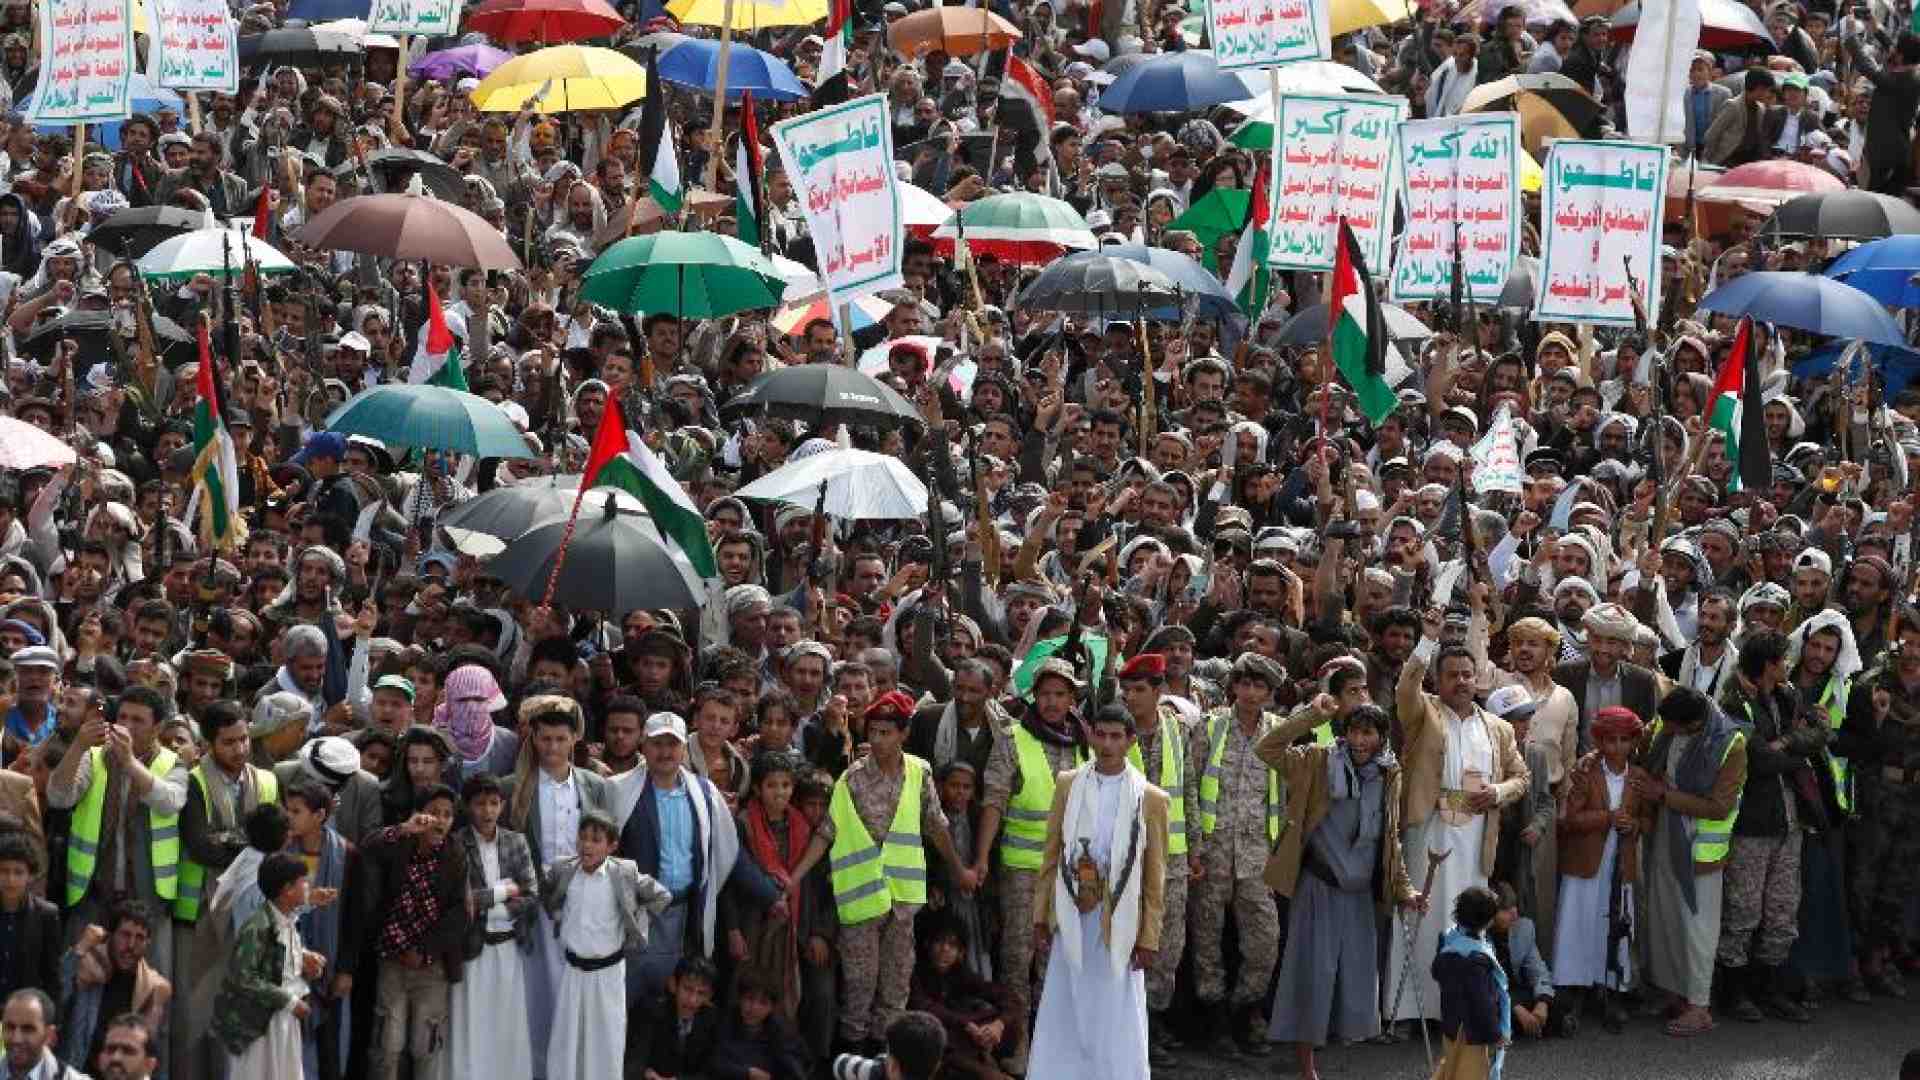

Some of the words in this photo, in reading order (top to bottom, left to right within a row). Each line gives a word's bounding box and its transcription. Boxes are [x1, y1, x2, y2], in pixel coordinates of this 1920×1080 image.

[1351, 112, 1390, 140] الله
[1470, 129, 1508, 159] الله
[1555, 156, 1656, 192] قاطعوا
[1602, 205, 1649, 238] البضائع
